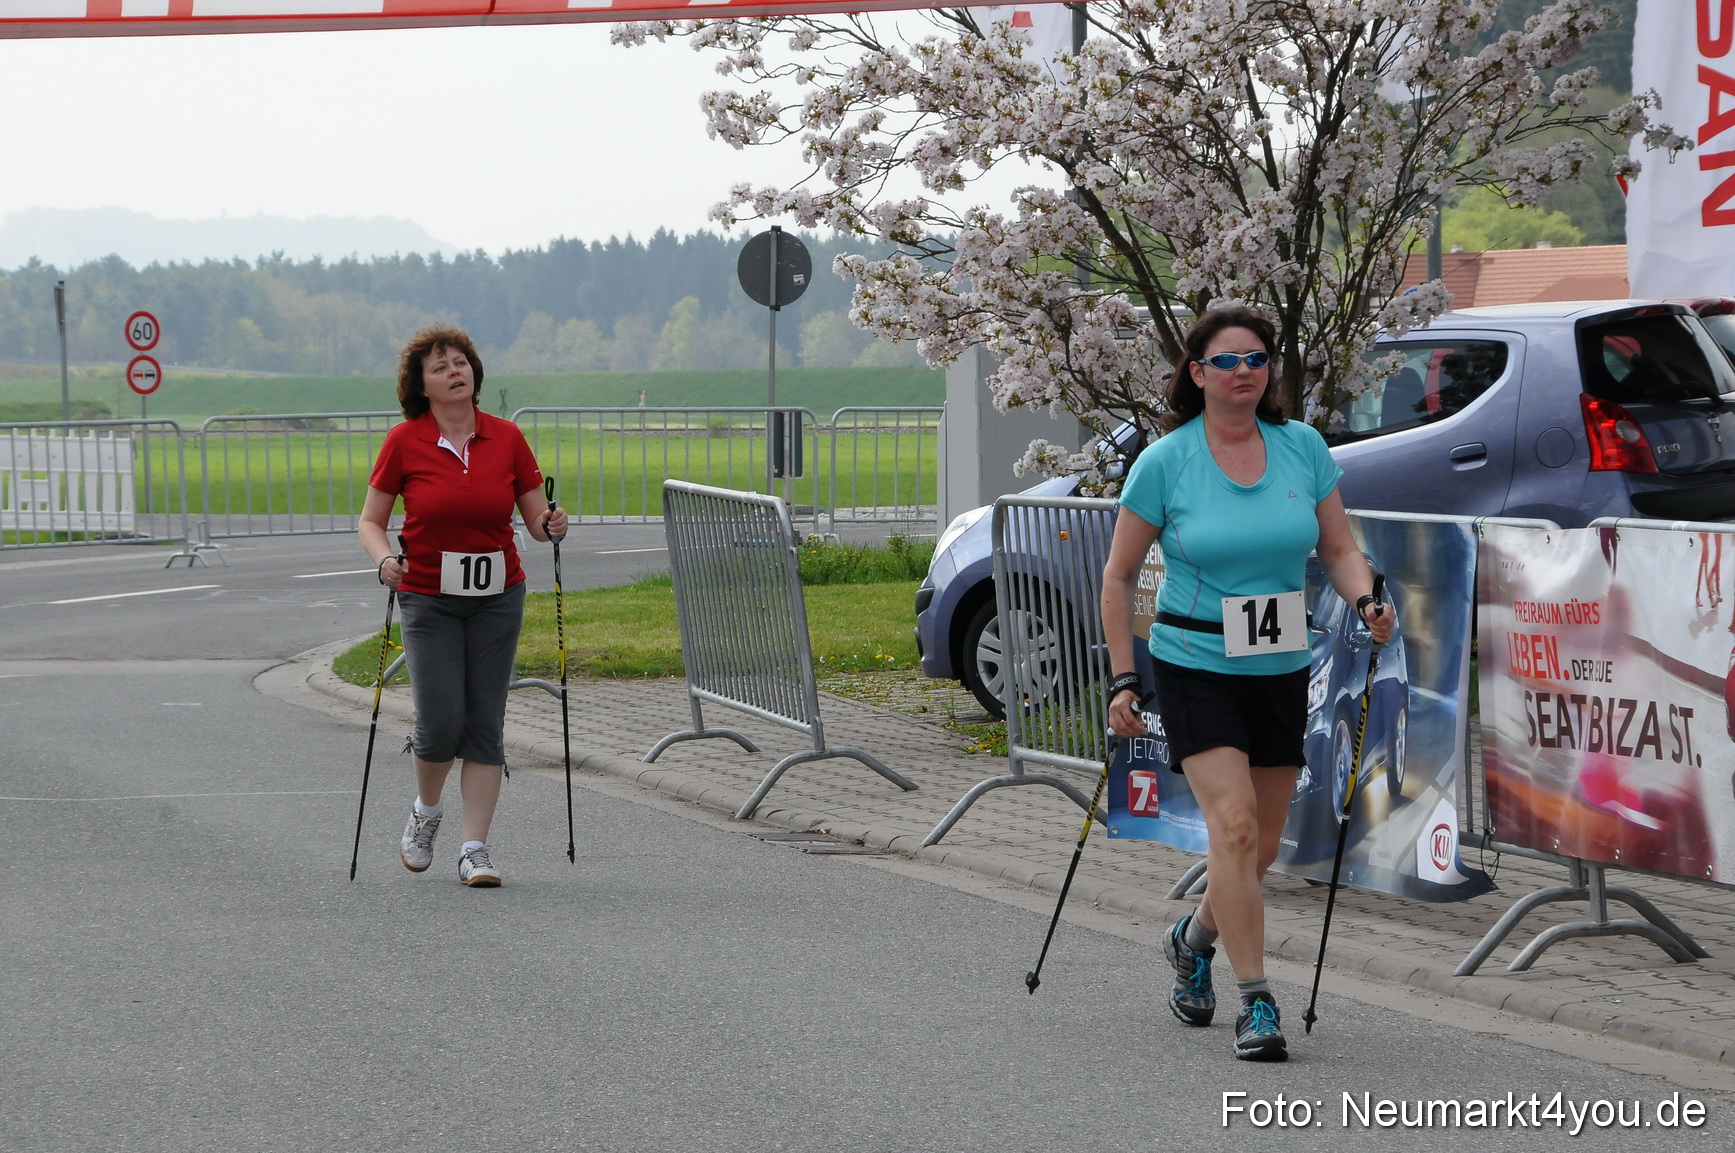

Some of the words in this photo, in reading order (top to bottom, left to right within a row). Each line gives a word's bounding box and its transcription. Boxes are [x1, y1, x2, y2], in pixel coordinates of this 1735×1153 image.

[132, 322, 153, 340] 60
[460, 555, 492, 590] 10
[1242, 597, 1281, 646] 14
[1514, 600, 1563, 625] FREIRAUM
[1564, 598, 1600, 625] FÜRS
[1507, 632, 1570, 681] LEBEN.
[1524, 690, 1587, 750] SEAT
[1668, 703, 1703, 769] ST.
[1133, 776, 1151, 811] 7
[1434, 833, 1450, 860] KIA
